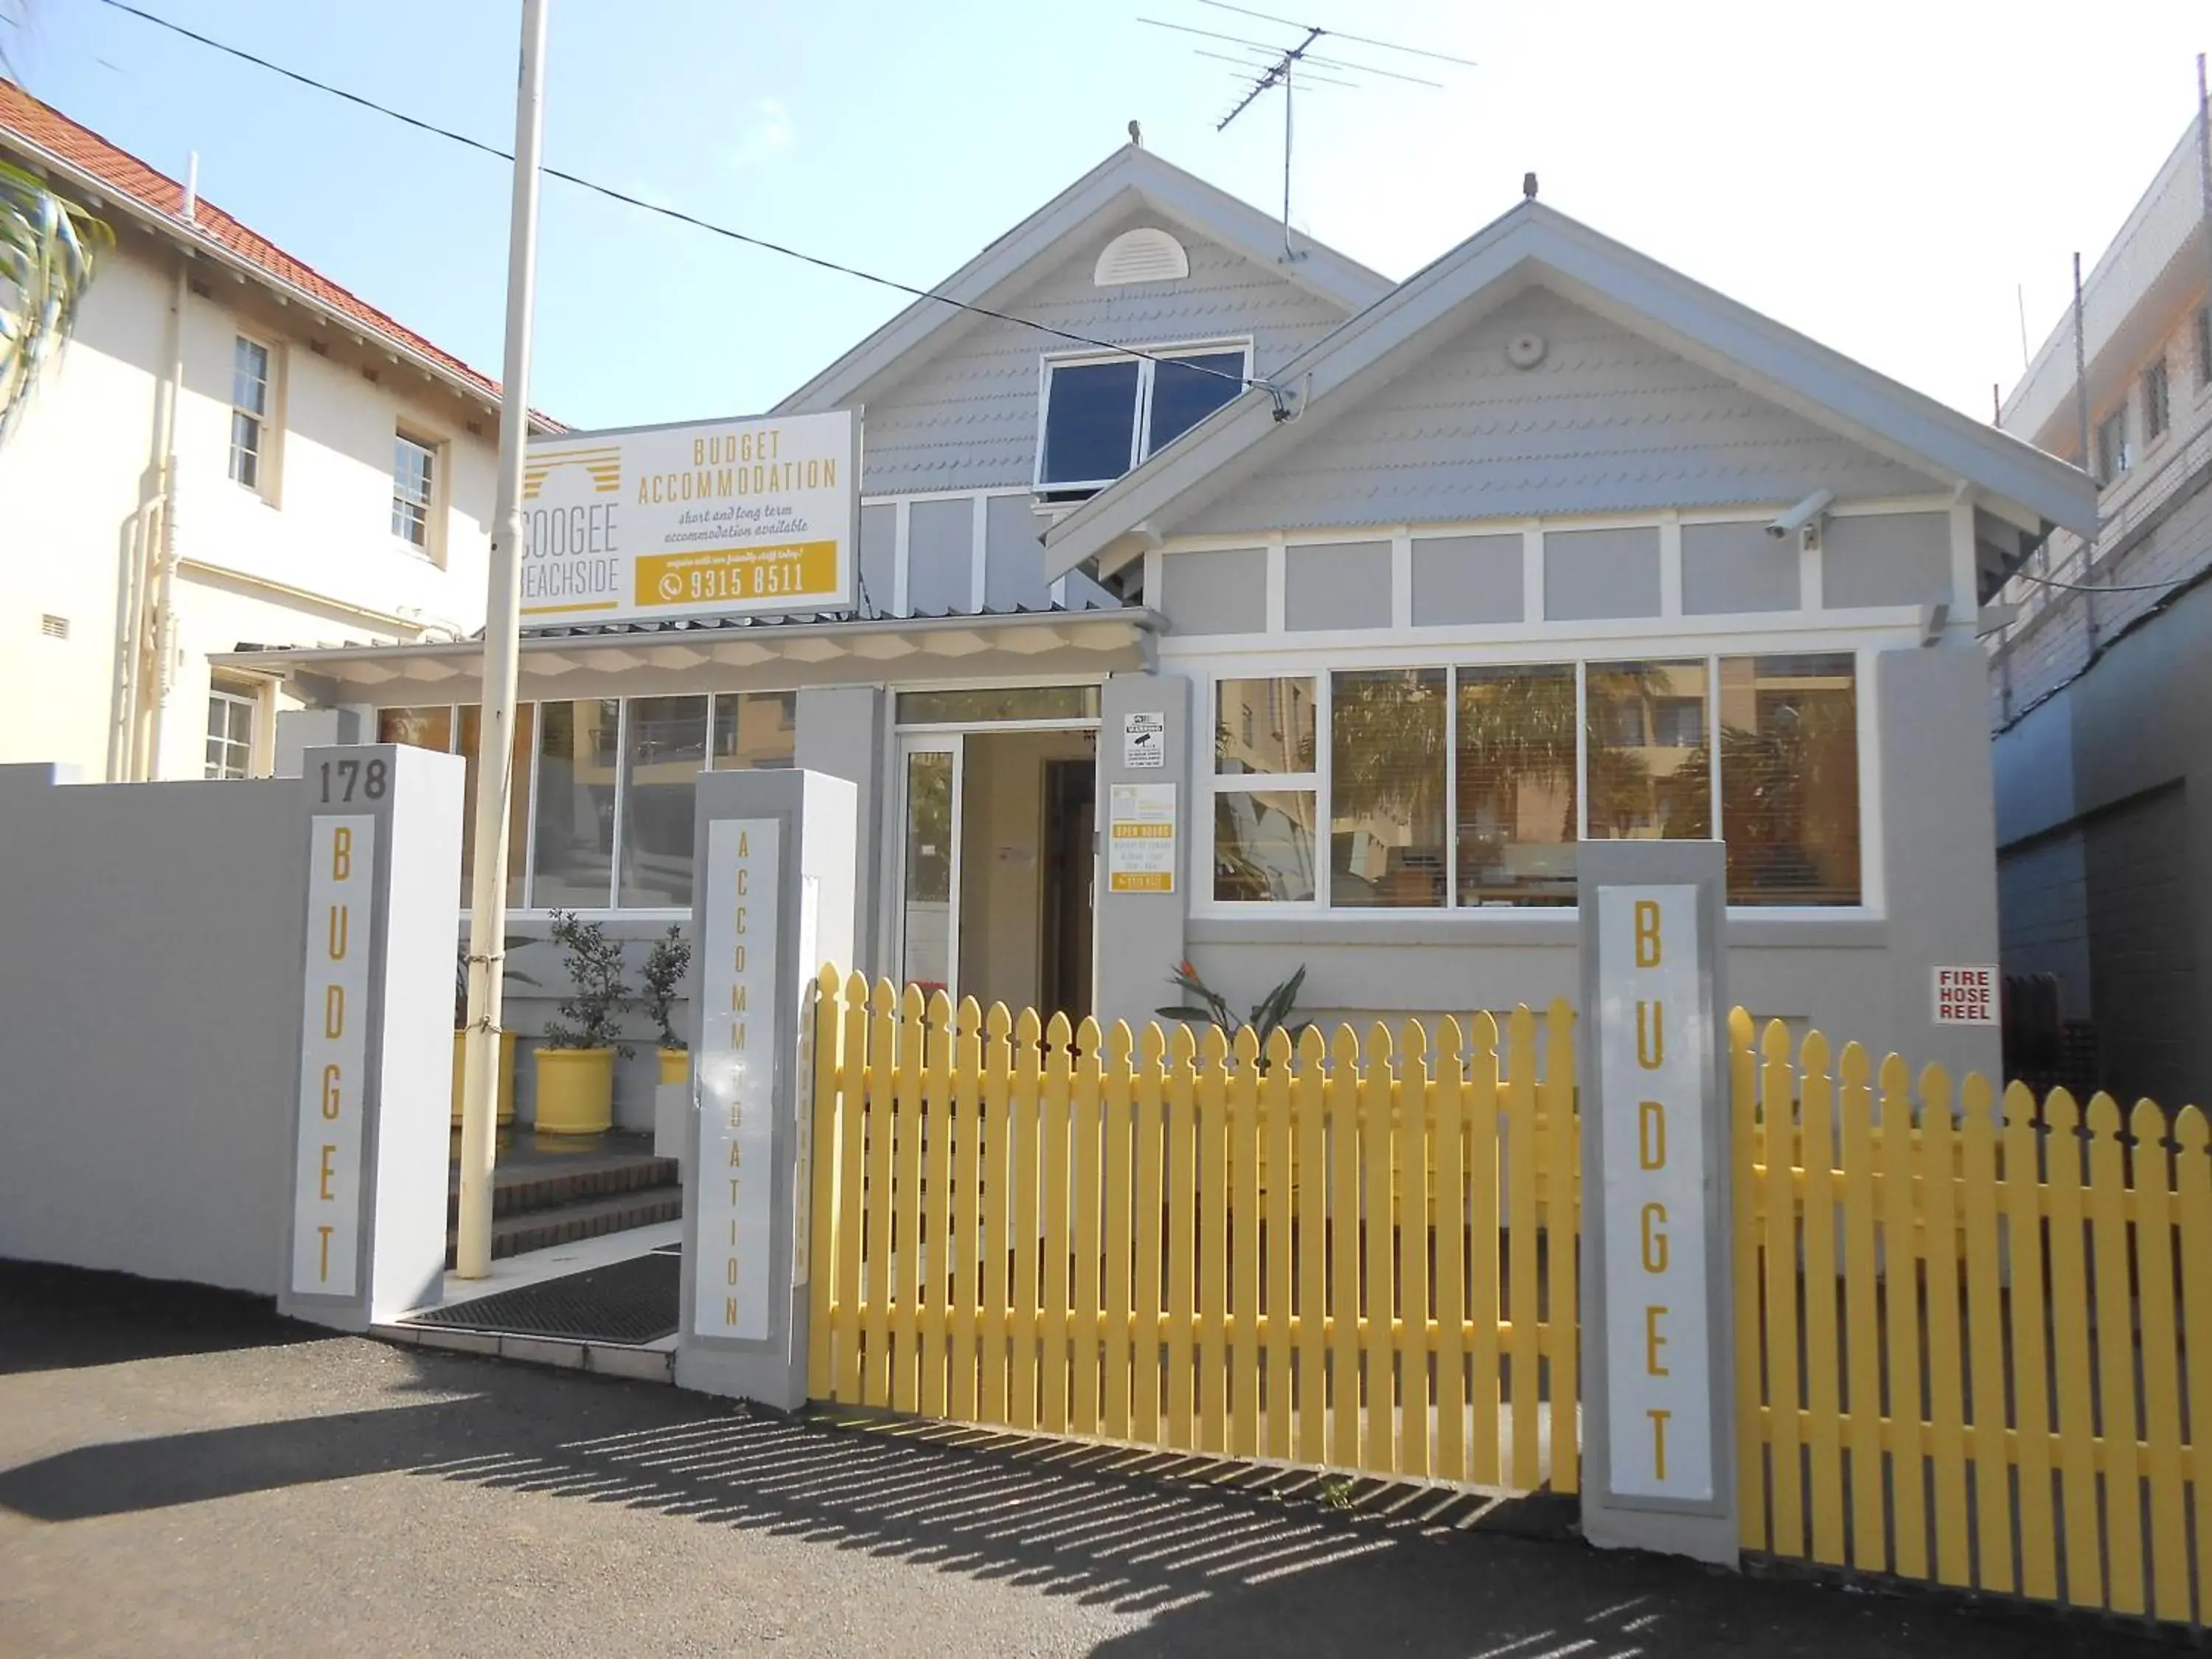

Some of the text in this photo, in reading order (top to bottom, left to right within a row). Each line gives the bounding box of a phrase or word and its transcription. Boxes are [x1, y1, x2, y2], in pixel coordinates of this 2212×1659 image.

[694, 431, 779, 466] BUDGET
[639, 459, 836, 504] ACCOMMODATION
[664, 518, 808, 543] accommodation available
[679, 504, 793, 525] short and long term
[691, 563, 802, 598] 9315 8511
[320, 759, 388, 803] 178
[1940, 971, 1989, 985] FIRE
[1940, 988, 1990, 1003] HOSE
[1940, 1004, 1990, 1019] REEL
[318, 827, 352, 1282] BUDGET
[1634, 900, 1672, 1481] BUDGET
